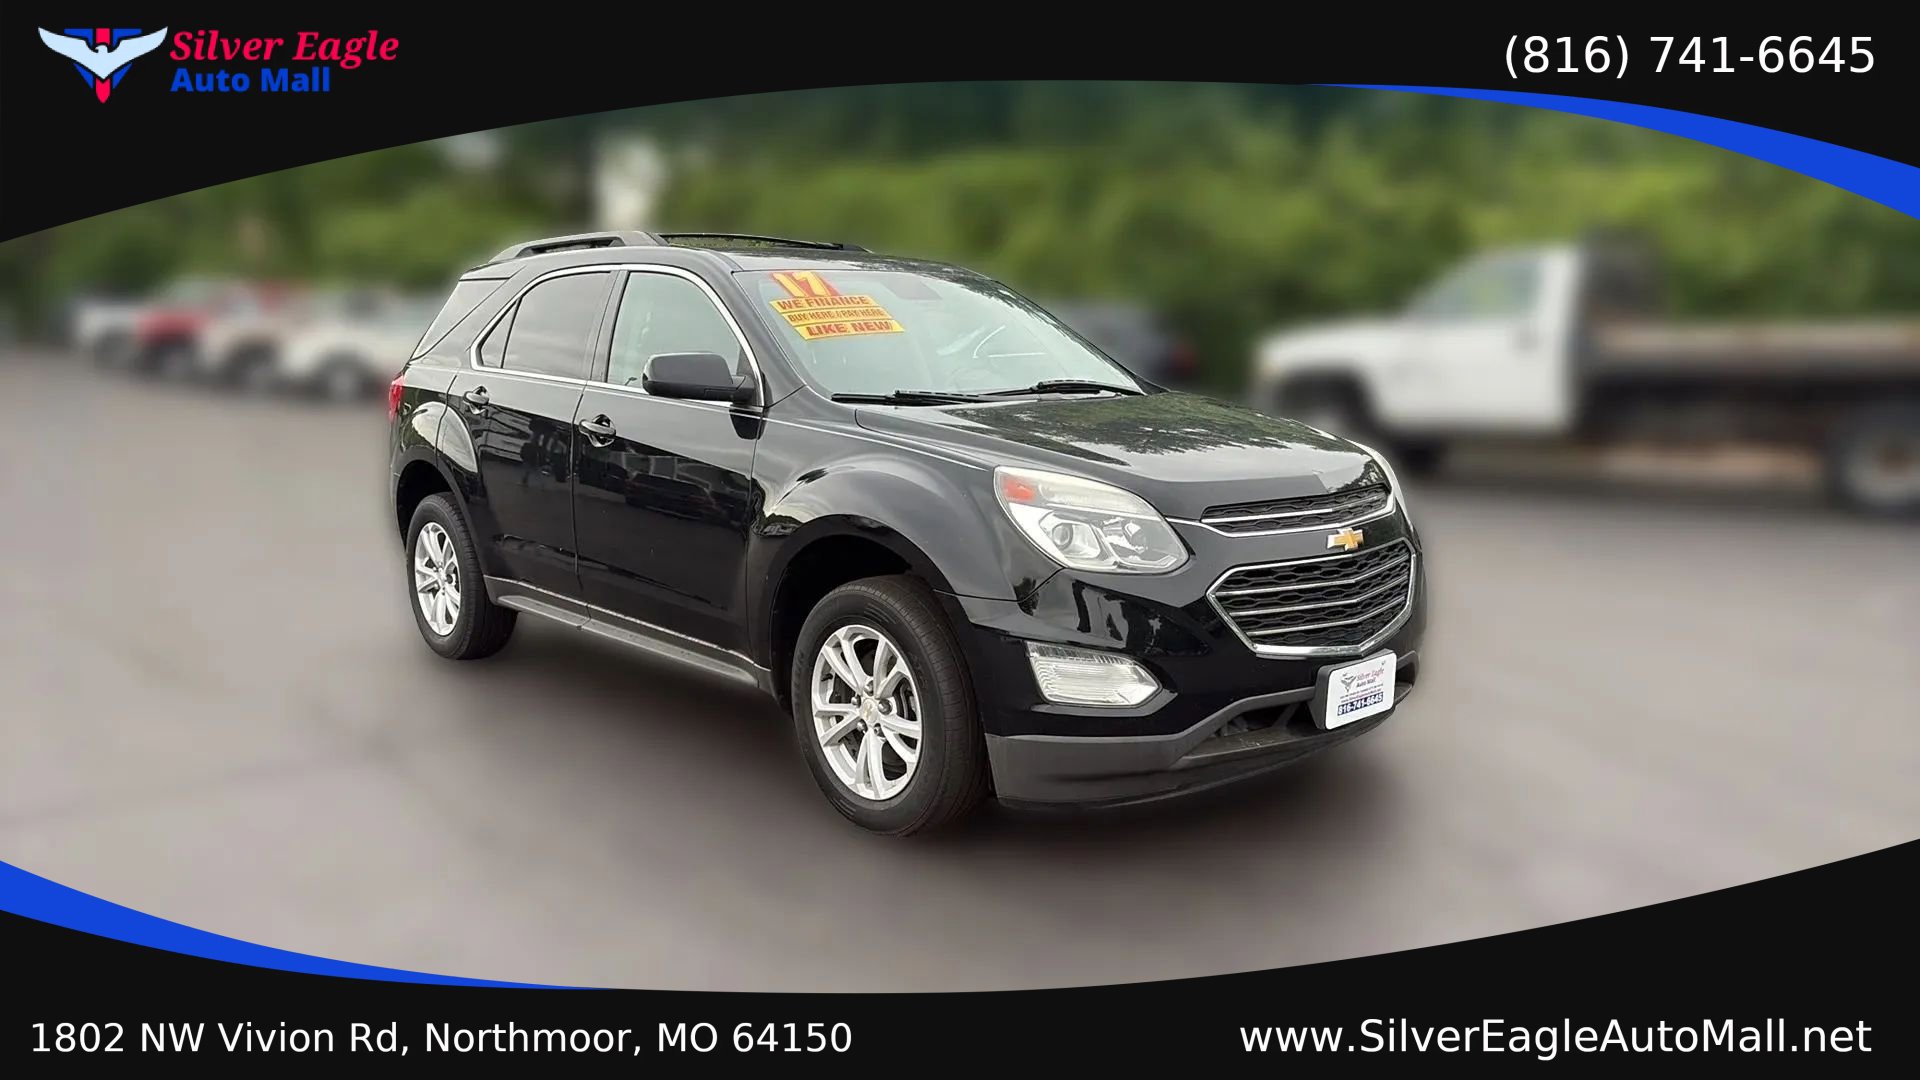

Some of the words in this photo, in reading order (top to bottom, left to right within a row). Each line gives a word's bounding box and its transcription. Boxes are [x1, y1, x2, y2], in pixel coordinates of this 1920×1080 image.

[771, 271, 834, 297] 17
[777, 299, 804, 310] WE
[805, 296, 870, 308] FINANCE
[787, 312, 807, 322] BUY
[810, 310, 834, 320] HERE
[842, 309, 861, 318] PAY
[861, 308, 885, 317] HERE
[805, 322, 846, 337] LIKE
[851, 321, 893, 332] NEW
[1338, 692, 1383, 715] 816-741-6645
